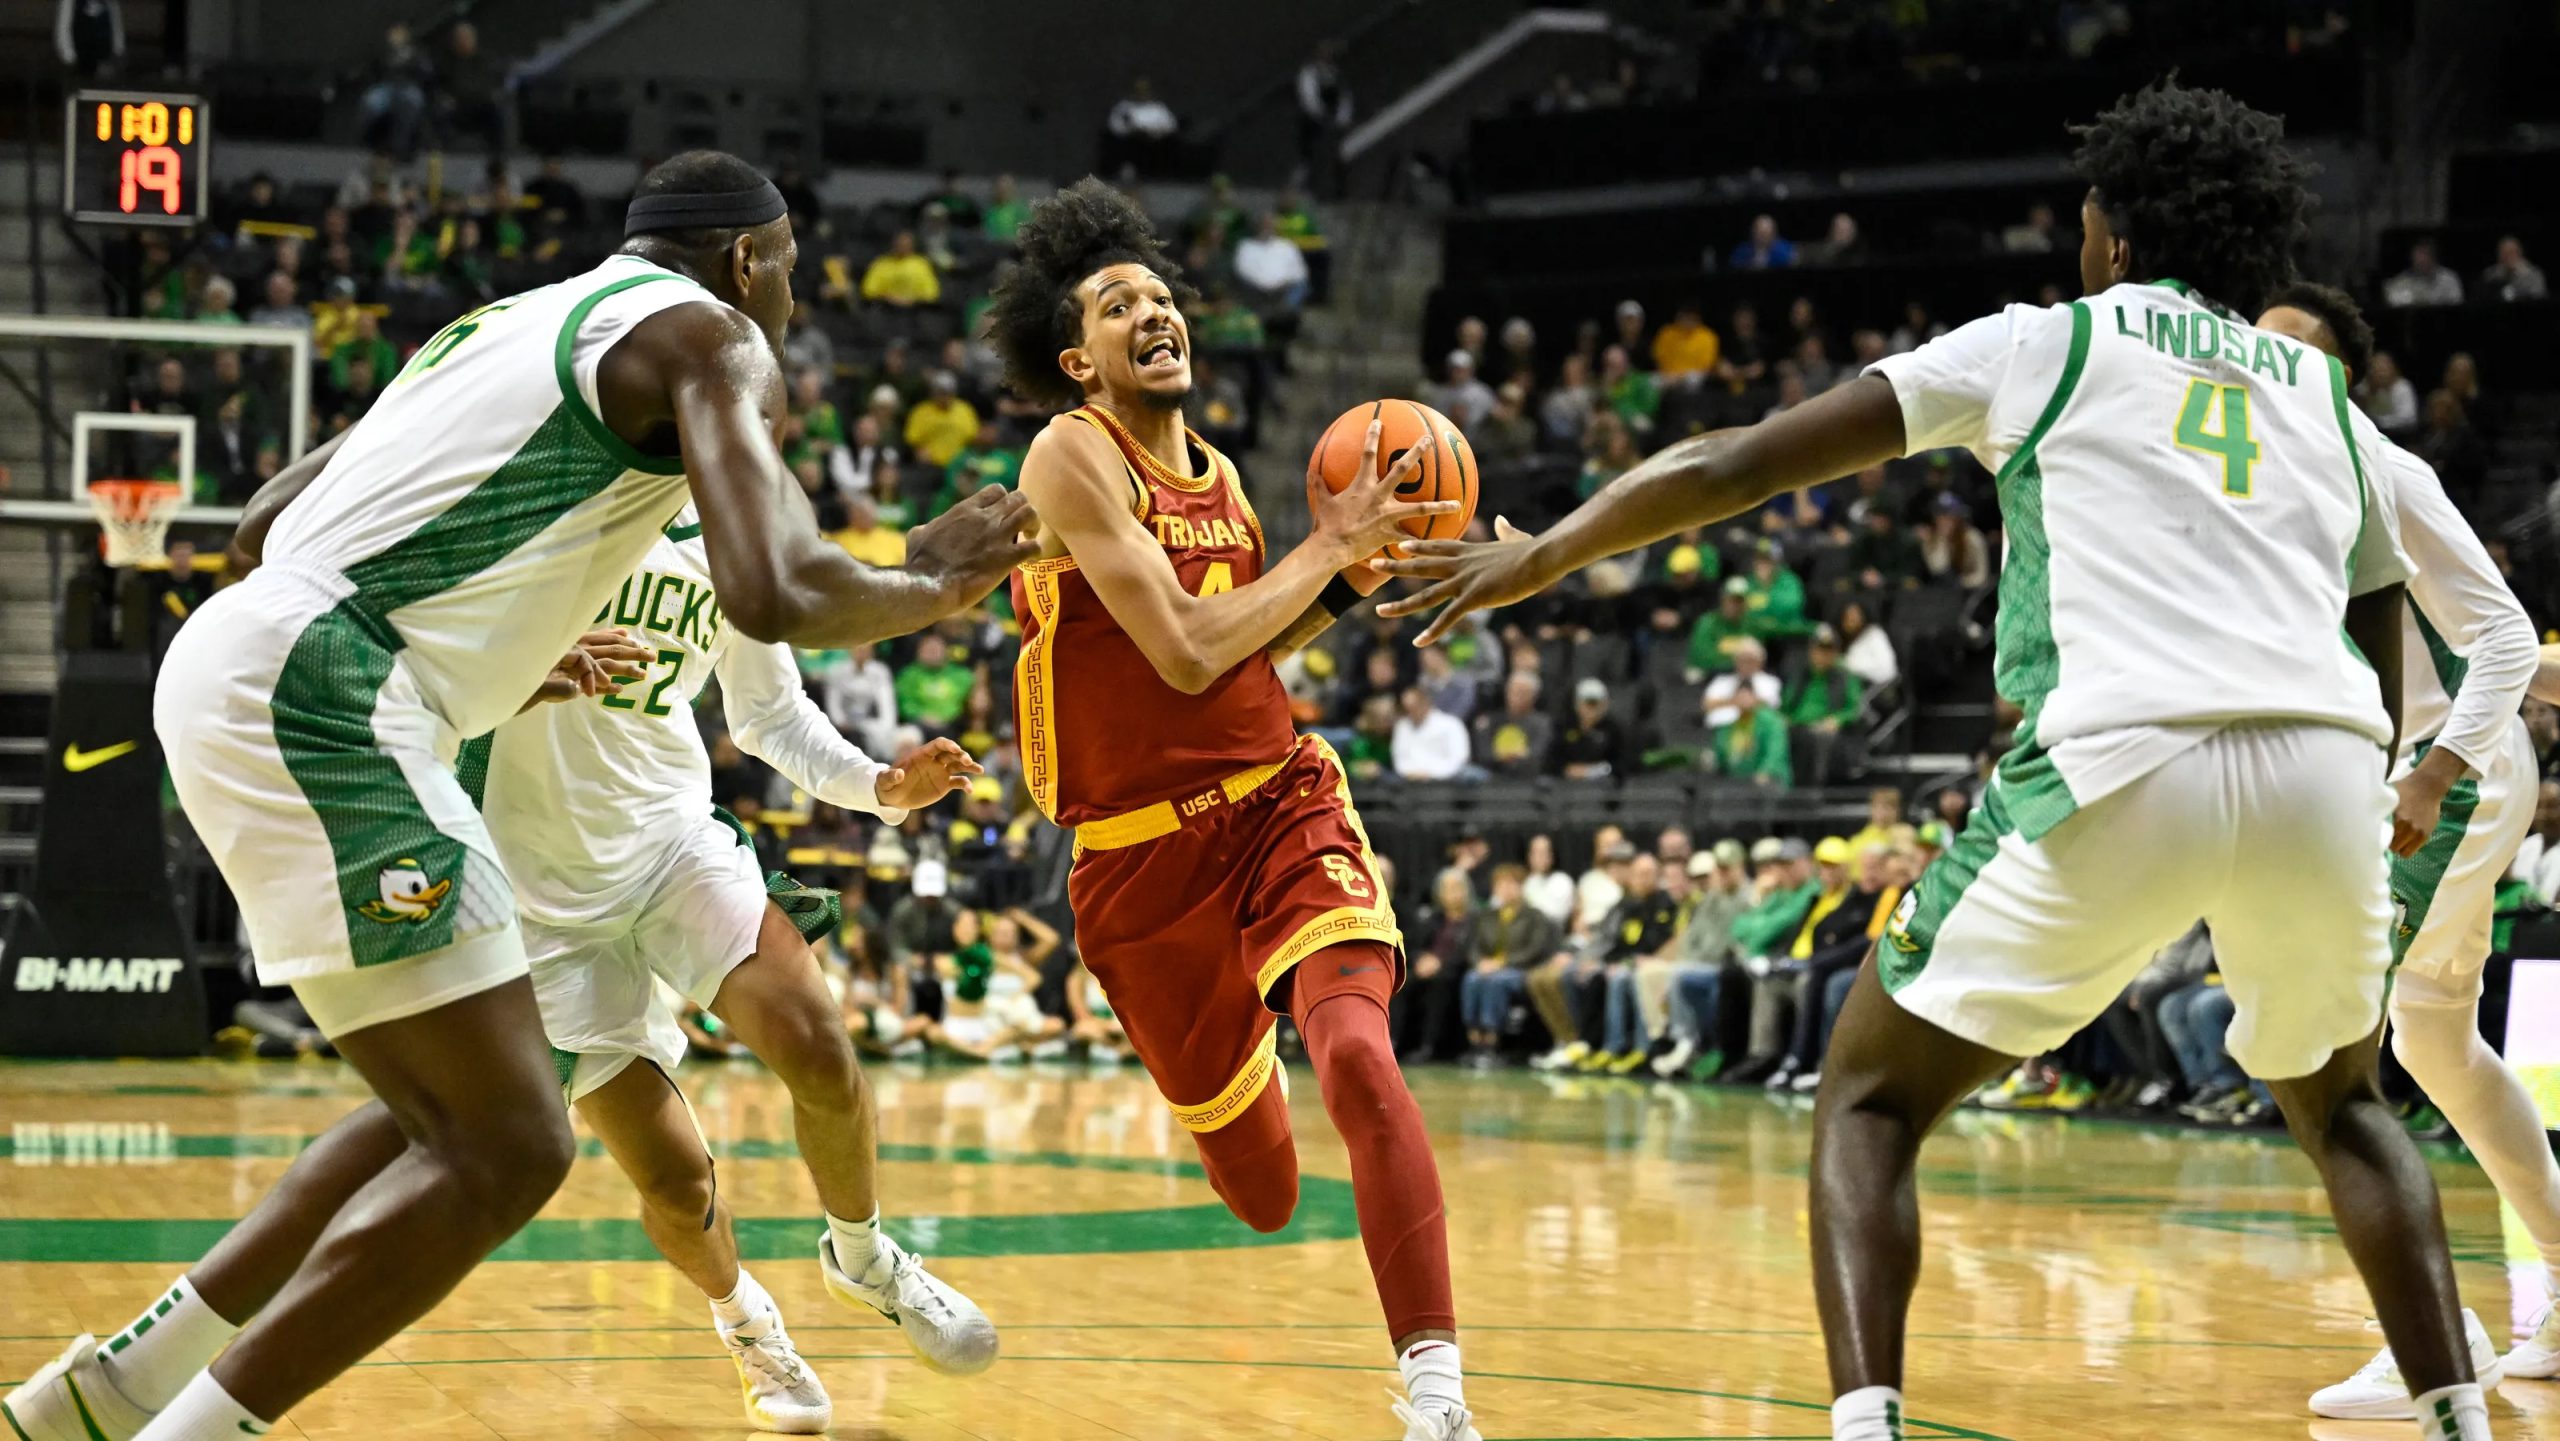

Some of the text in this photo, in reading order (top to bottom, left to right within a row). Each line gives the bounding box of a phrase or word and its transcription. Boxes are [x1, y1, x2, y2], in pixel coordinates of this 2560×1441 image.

[97, 102, 193, 146] 11:01
[120, 146, 181, 214] 19
[2115, 305, 2304, 387] LINDSAY
[2173, 376, 2262, 498] 4
[594, 572, 726, 654] UCKS
[1181, 789, 1221, 817] USC
[1322, 854, 1370, 898] SC
